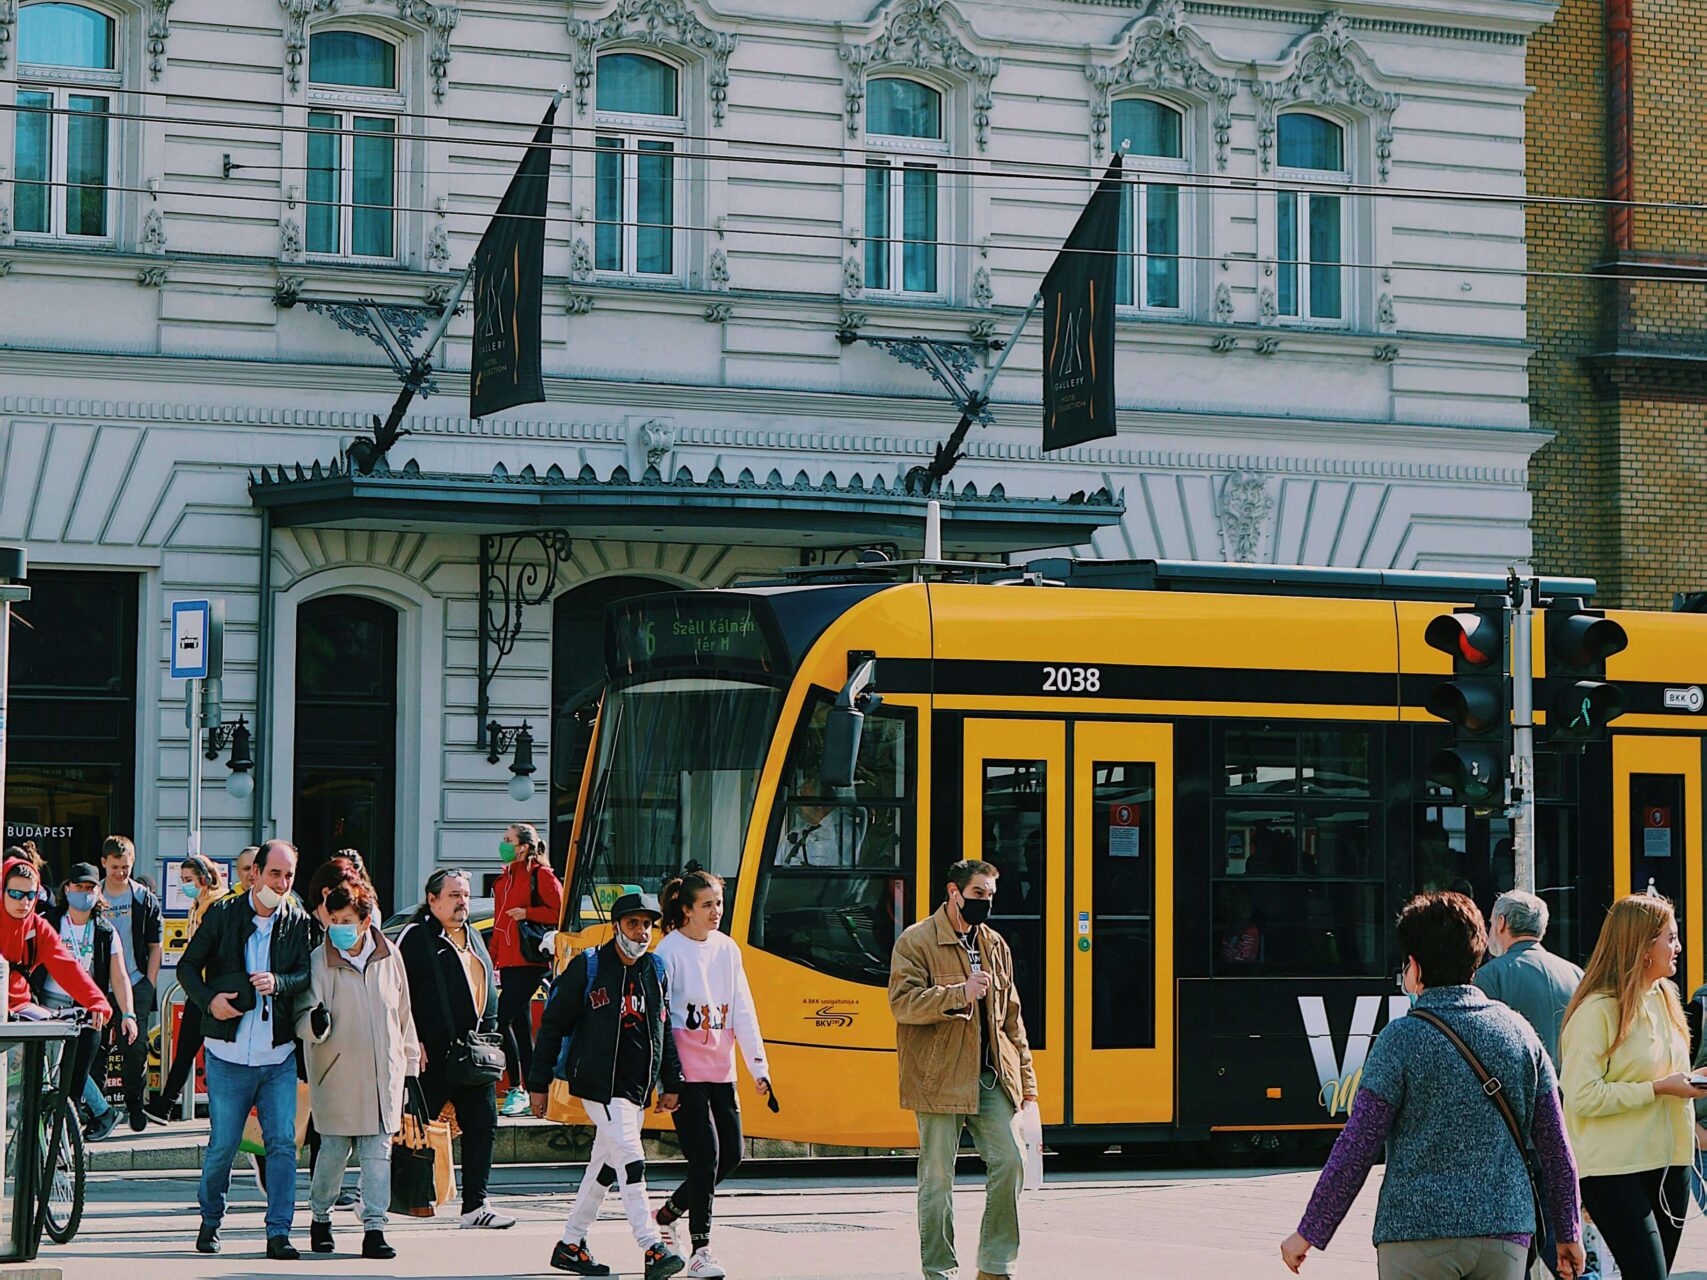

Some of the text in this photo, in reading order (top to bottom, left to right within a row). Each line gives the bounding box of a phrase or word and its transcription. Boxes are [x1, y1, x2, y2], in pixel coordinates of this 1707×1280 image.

[673, 619, 705, 635] Széll
[697, 636, 730, 652] tér M
[1042, 666, 1101, 692] 2038
[1669, 693, 1687, 702] BKK
[7, 826, 74, 838] BUDAPEST
